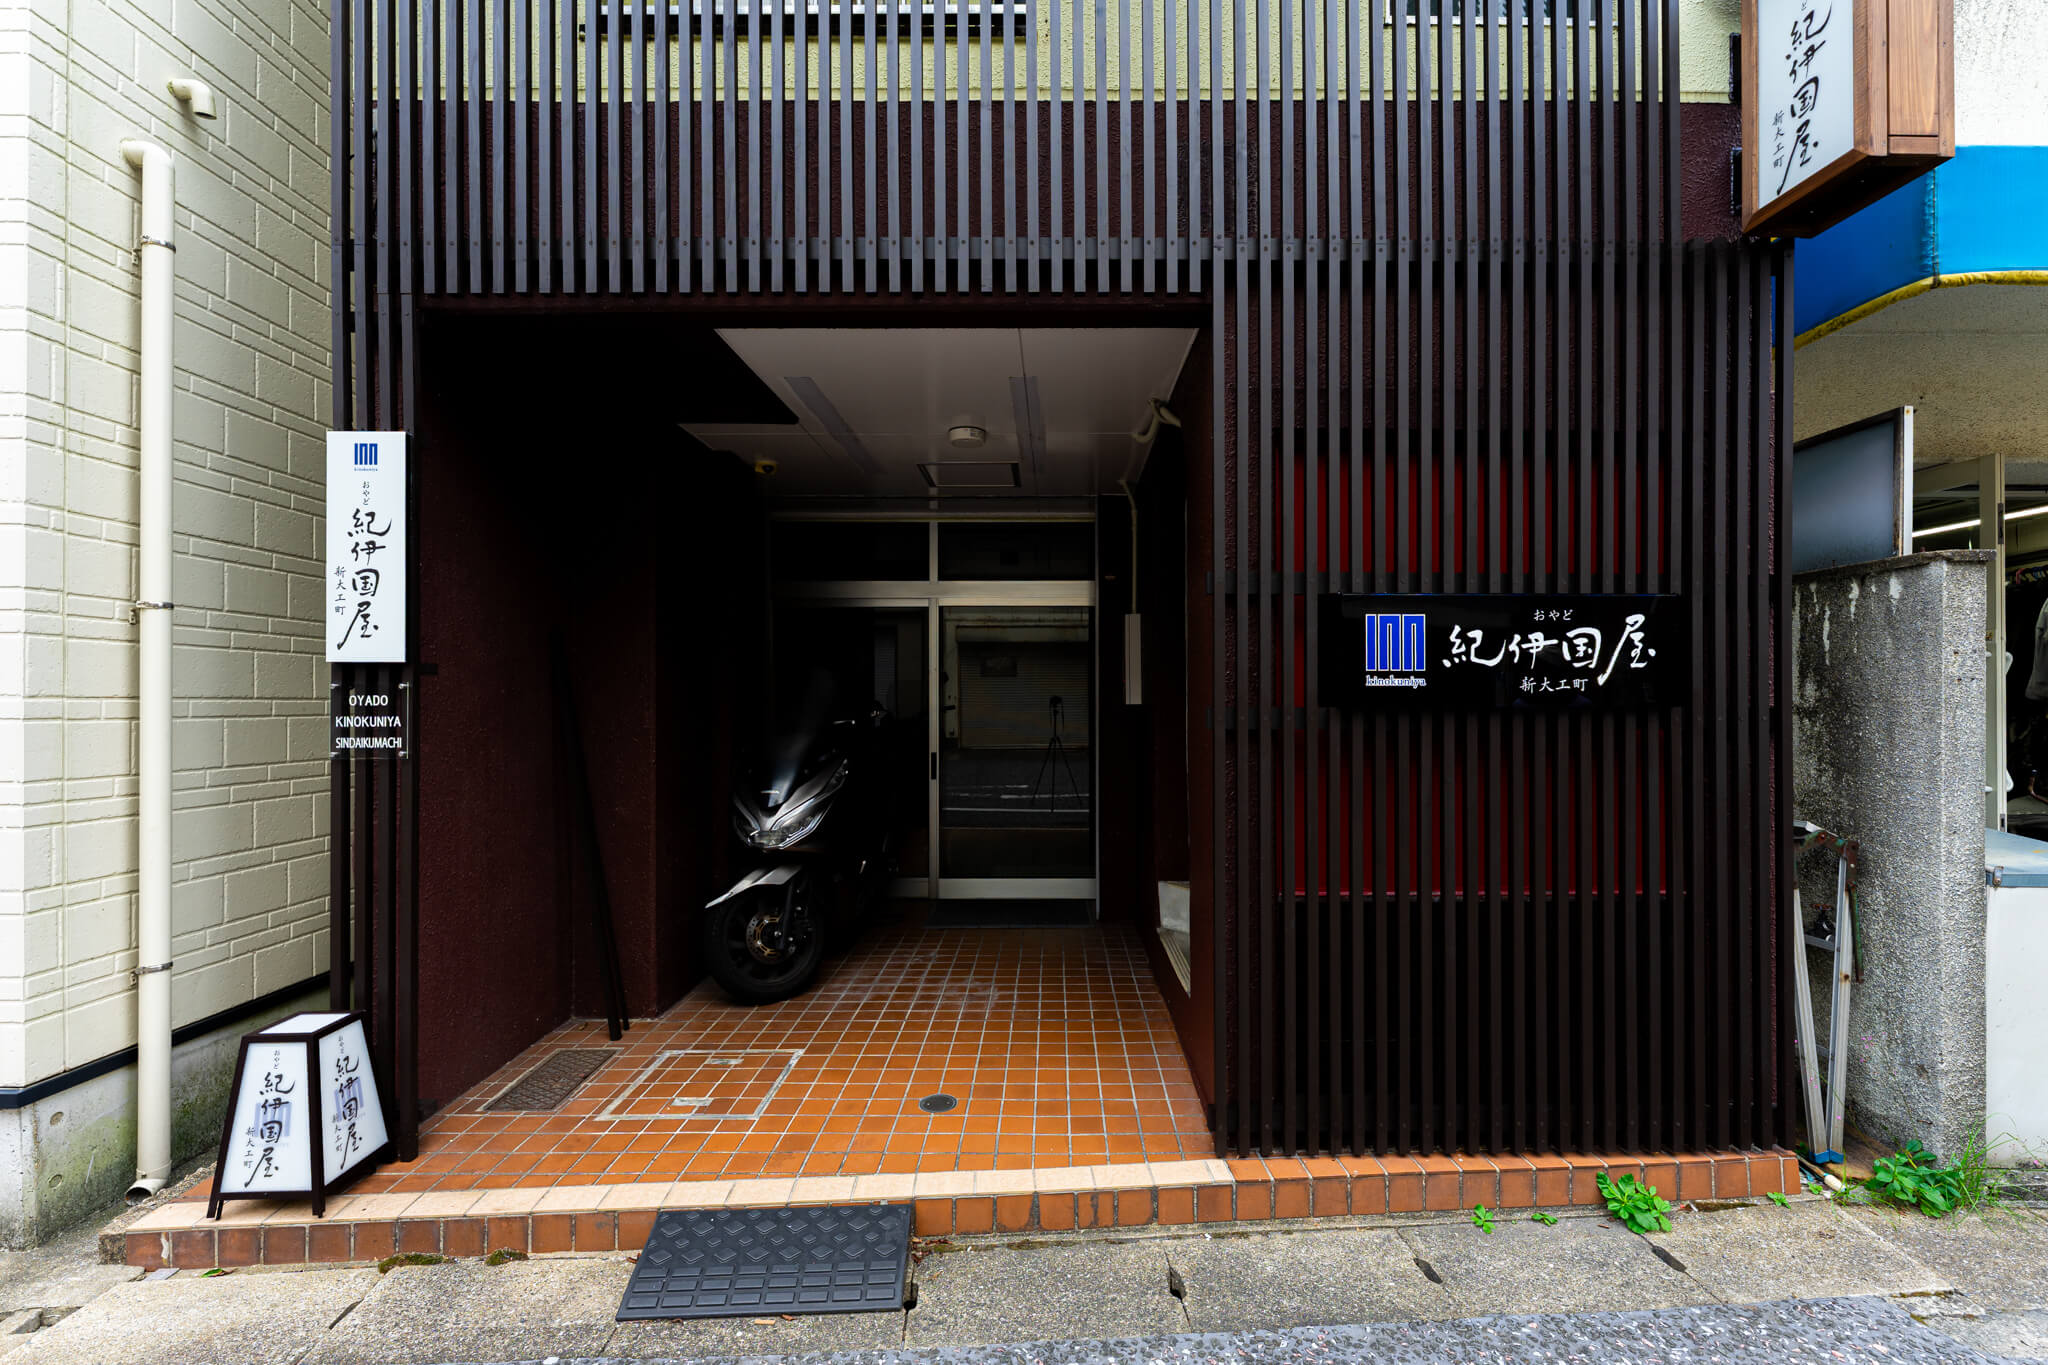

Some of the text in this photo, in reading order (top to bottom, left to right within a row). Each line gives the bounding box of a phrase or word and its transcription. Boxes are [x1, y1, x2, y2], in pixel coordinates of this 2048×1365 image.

[1776, 0, 1832, 195] 紀伊国屋
[1772, 110, 1785, 168] 新大工町
[362, 481, 370, 506] おやど
[334, 566, 346, 615] 新大工町
[337, 508, 392, 650] 紀伊国屋
[1534, 609, 1573, 622] おやど
[1442, 613, 1656, 686] 紀伊国屋
[348, 695, 388, 706] OYADO
[1366, 675, 1426, 689] kinokuniya
[1519, 677, 1588, 693] 新大工町
[335, 716, 401, 728] KINOKUNIYA
[335, 737, 402, 749] SINDAIKUMACHI
[245, 1072, 295, 1188] 紀伊国屋
[335, 1055, 363, 1170] 紀伊国屋
[243, 1127, 256, 1168] 新大工町
